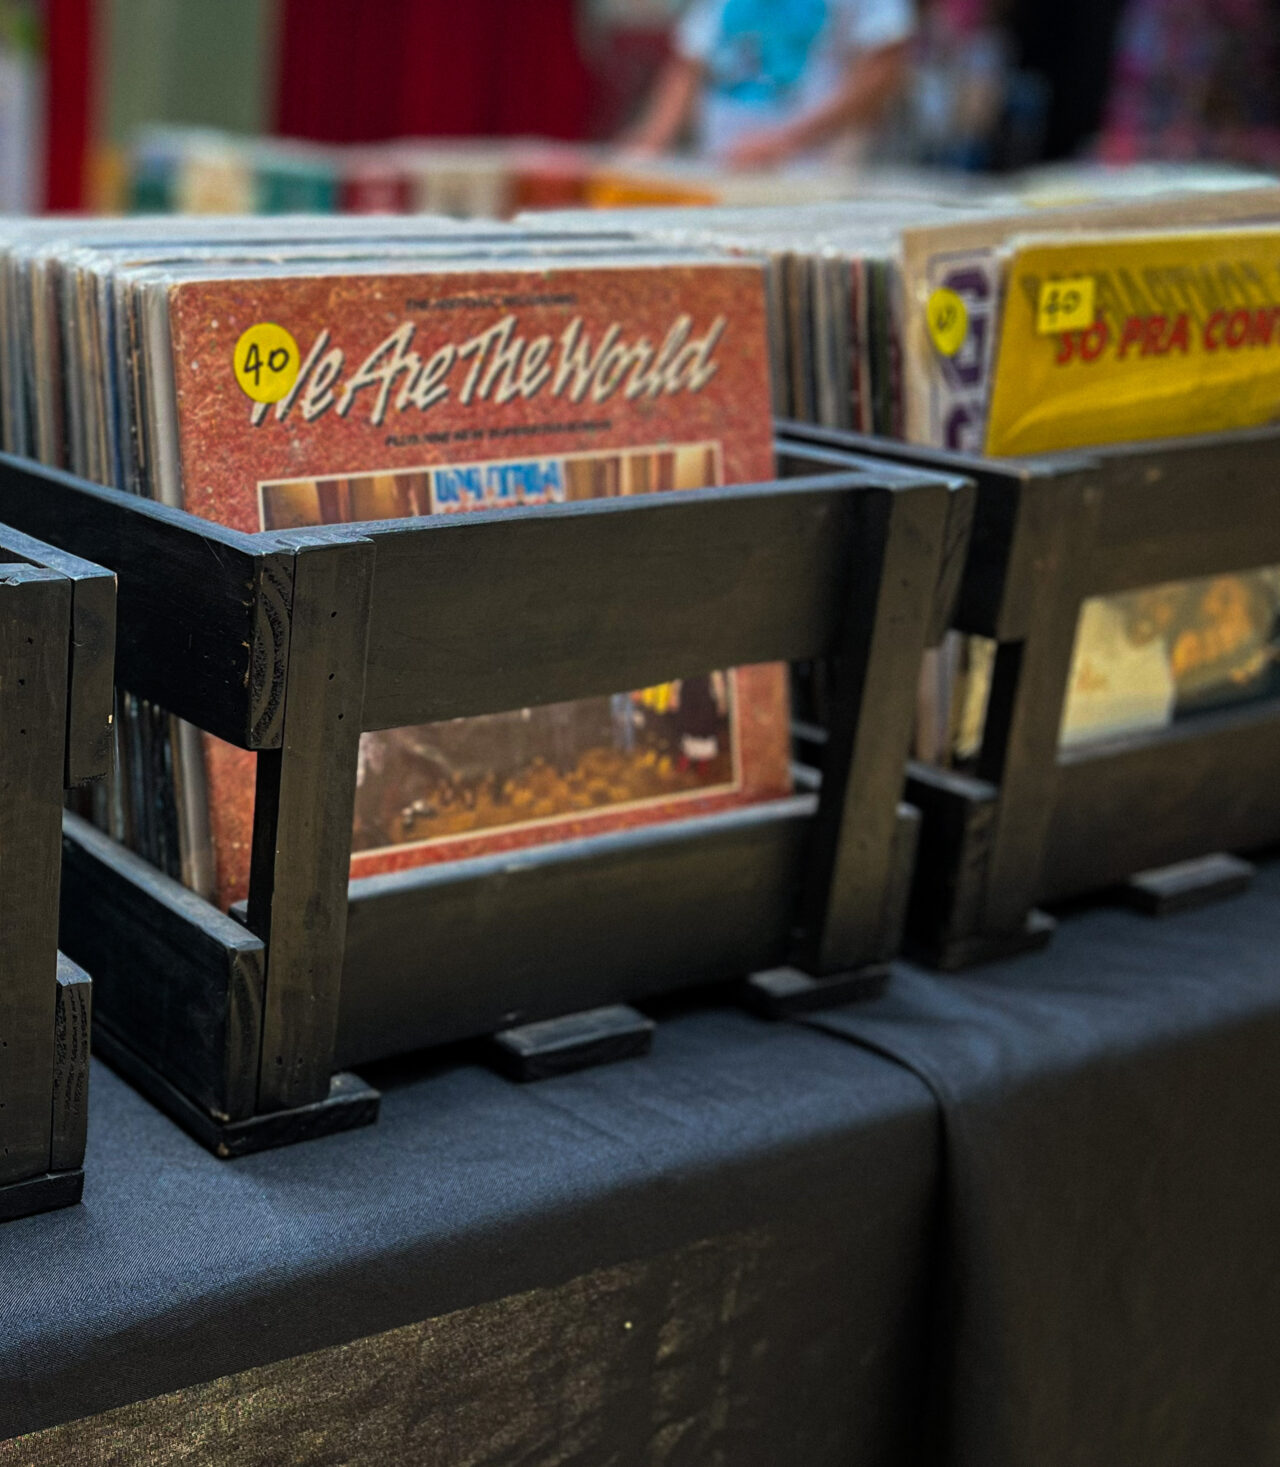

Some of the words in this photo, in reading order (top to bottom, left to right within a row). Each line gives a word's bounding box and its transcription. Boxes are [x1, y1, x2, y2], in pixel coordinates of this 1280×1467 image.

[1204, 306, 1280, 351] CON
[243, 343, 290, 387] 40
[335, 321, 458, 428] Are
[457, 314, 552, 406] The
[550, 316, 727, 404] World
